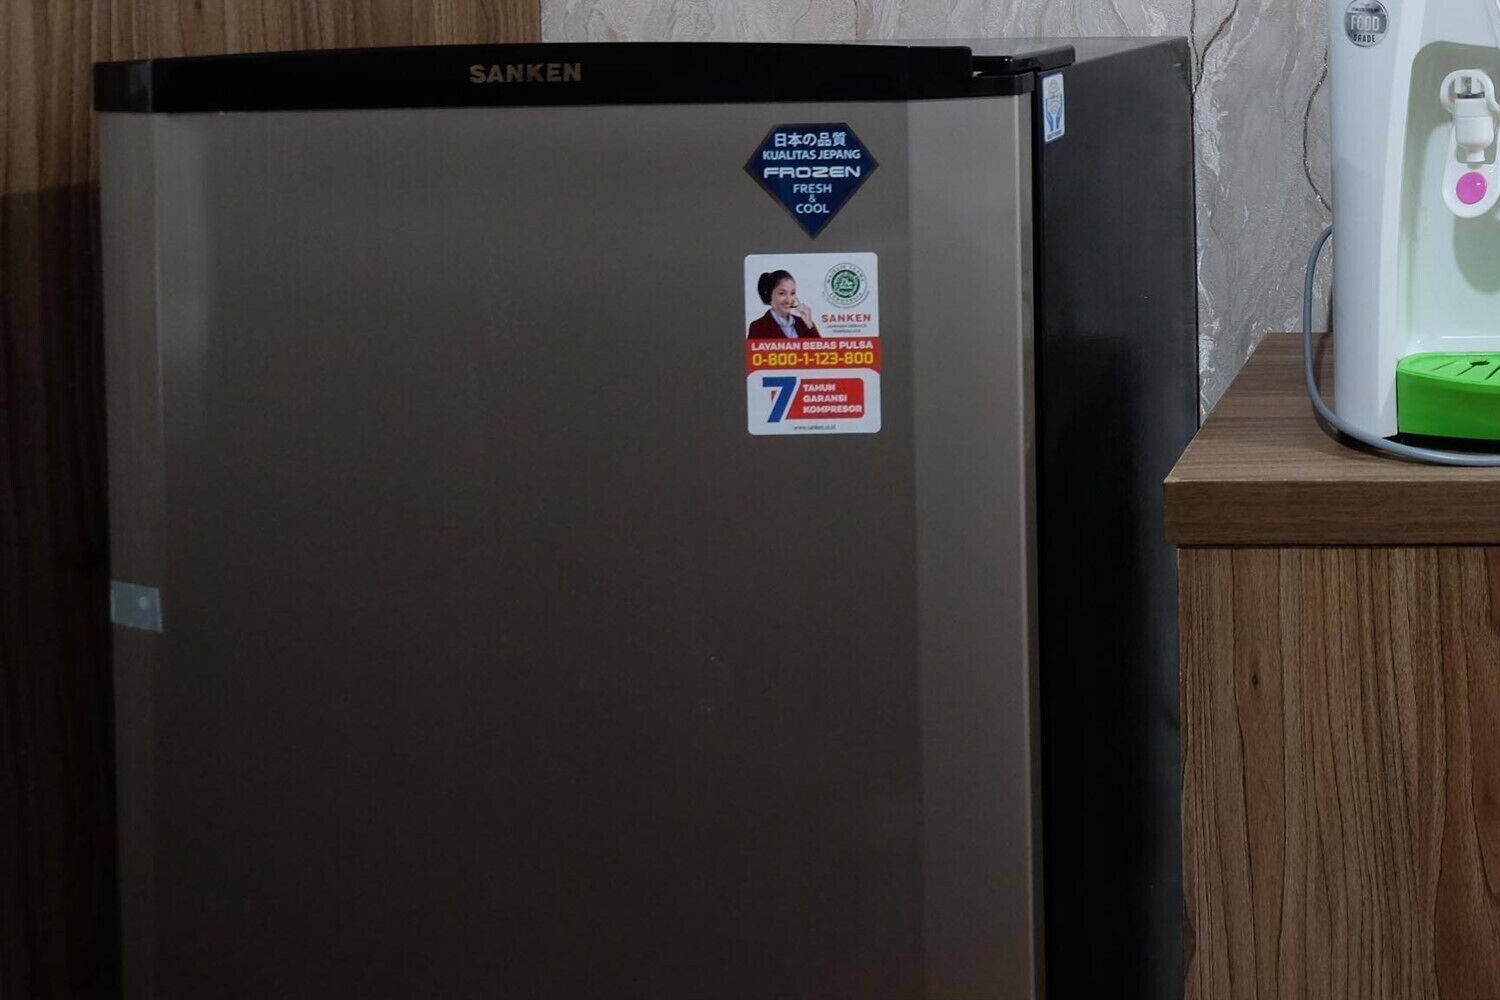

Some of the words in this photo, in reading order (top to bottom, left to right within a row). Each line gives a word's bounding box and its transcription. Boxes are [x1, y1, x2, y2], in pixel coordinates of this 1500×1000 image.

[1350, 15, 1380, 31] FOOD
[1353, 34, 1376, 43] GRADE
[469, 62, 581, 84] SANKEN
[774, 132, 847, 148] 日本の品質
[762, 149, 816, 161] KUALITAS
[817, 149, 861, 160] JEPANG
[763, 166, 861, 179] FROZEN
[793, 184, 832, 194] FRESH
[808, 194, 817, 203] &
[796, 203, 830, 214] COOL
[821, 313, 872, 323] SANKEN
[751, 342, 801, 351] LAYANAN
[802, 341, 837, 350] BEBAS
[839, 341, 874, 349] PULSA
[752, 352, 874, 366] 0-800-1-123-800
[802, 384, 836, 392] TAHUN
[762, 376, 797, 423] 7
[802, 394, 848, 403] GARANSI
[802, 405, 863, 414] KOMPRESOR
